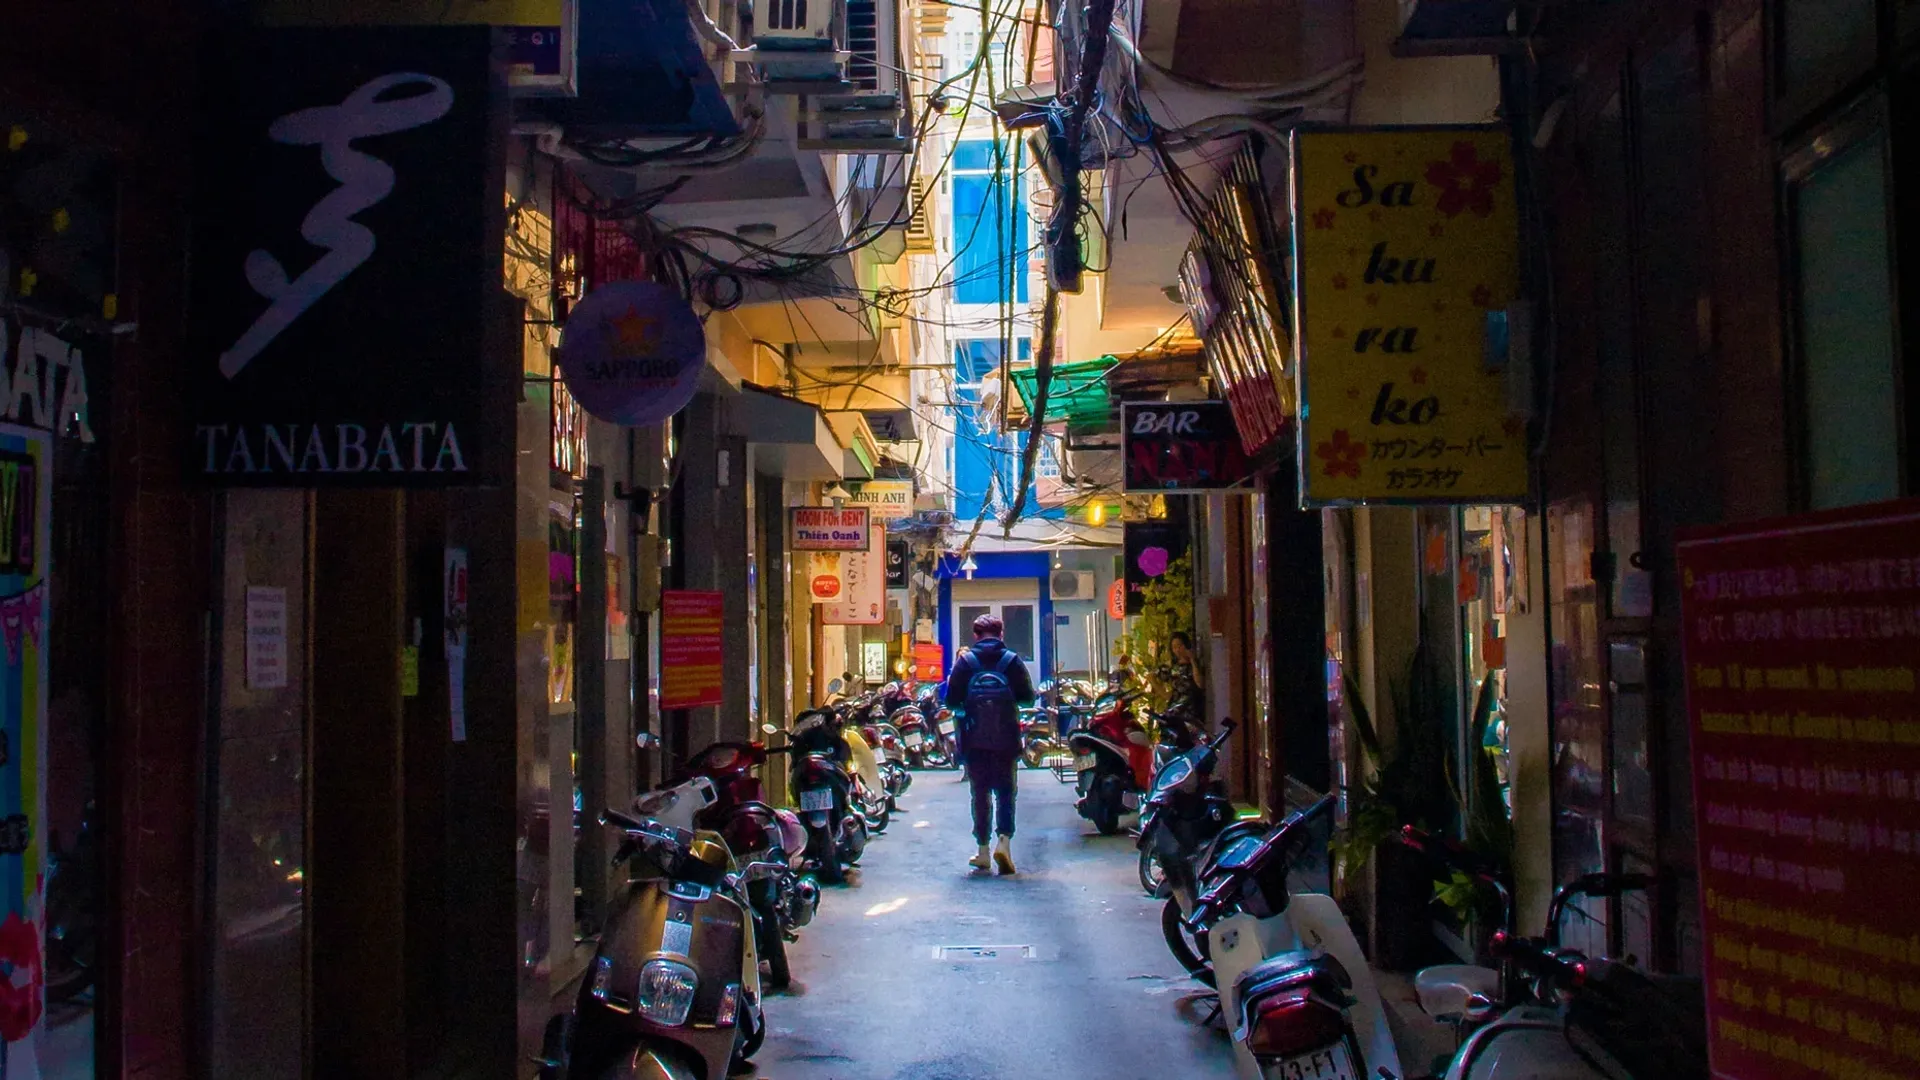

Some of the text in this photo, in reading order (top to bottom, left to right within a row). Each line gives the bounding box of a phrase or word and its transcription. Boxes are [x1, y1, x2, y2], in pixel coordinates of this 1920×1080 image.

[1336, 165, 1416, 207] Sa
[1363, 241, 1438, 284] ku
[1354, 326, 1420, 353] ra
[1371, 383, 1442, 425] ko
[1132, 411, 1200, 435] BAR
[196, 420, 470, 475] TANABATA
[1386, 466, 1465, 489] カラオケ
[850, 492, 905, 503] MINH ANH
[796, 511, 864, 526] ROOM FOR RENT
[832, 530, 860, 540] Oanh
[847, 551, 858, 619] となでしこ
